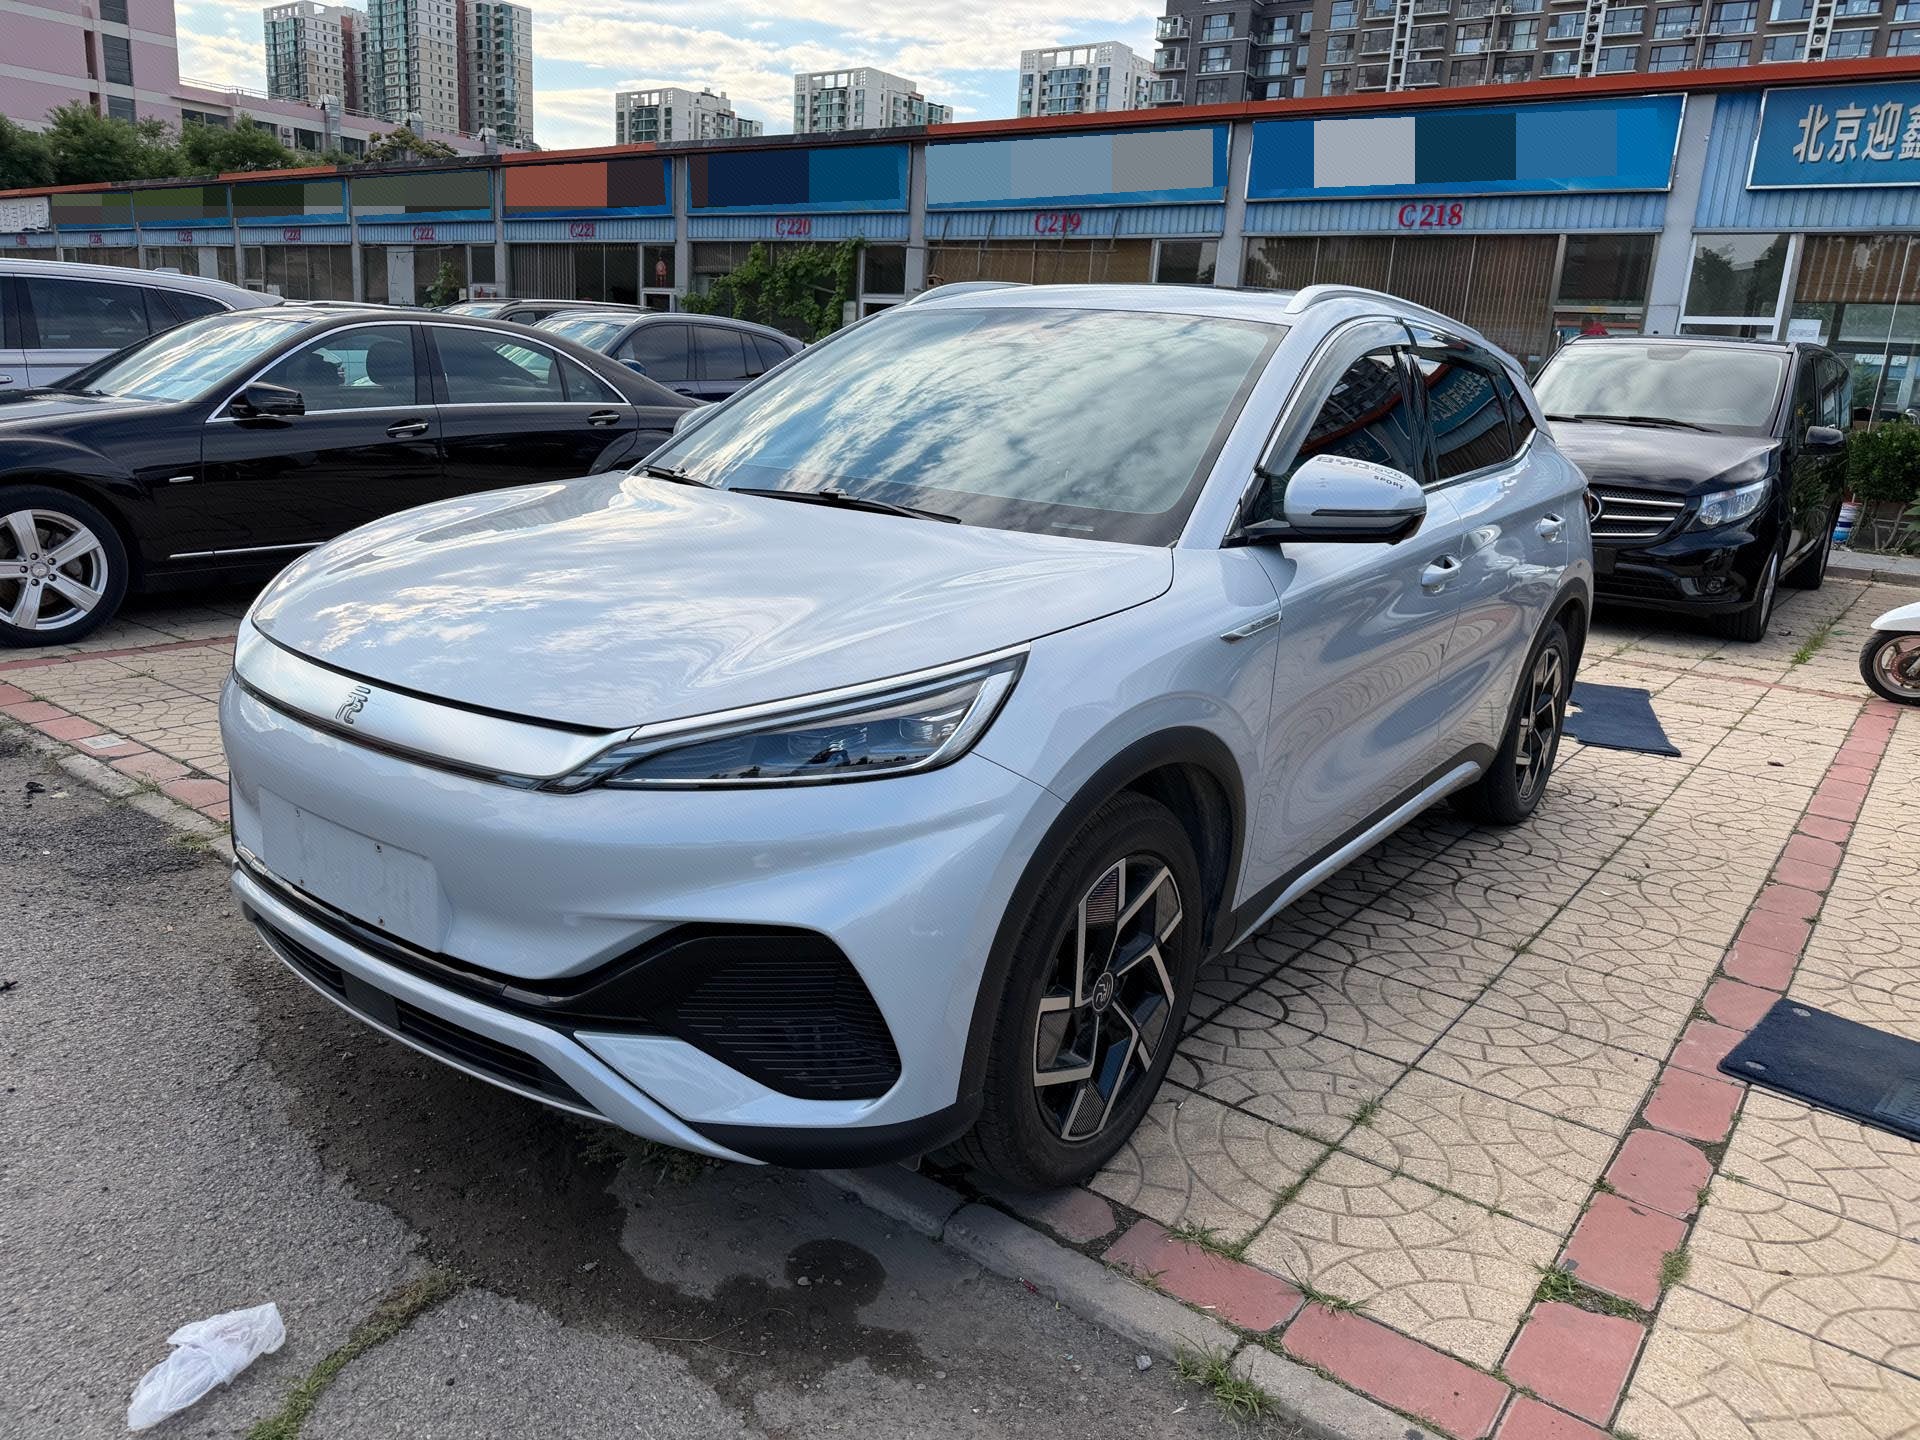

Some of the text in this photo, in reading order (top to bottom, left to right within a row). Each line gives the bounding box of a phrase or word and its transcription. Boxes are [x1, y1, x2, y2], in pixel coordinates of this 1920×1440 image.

[1035, 212, 1081, 233] C219
[1398, 203, 1463, 227] C218
[413, 225, 434, 241] C222
[569, 222, 595, 238] C221
[776, 216, 812, 236] C220
[1374, 475, 1404, 490] SPORT
